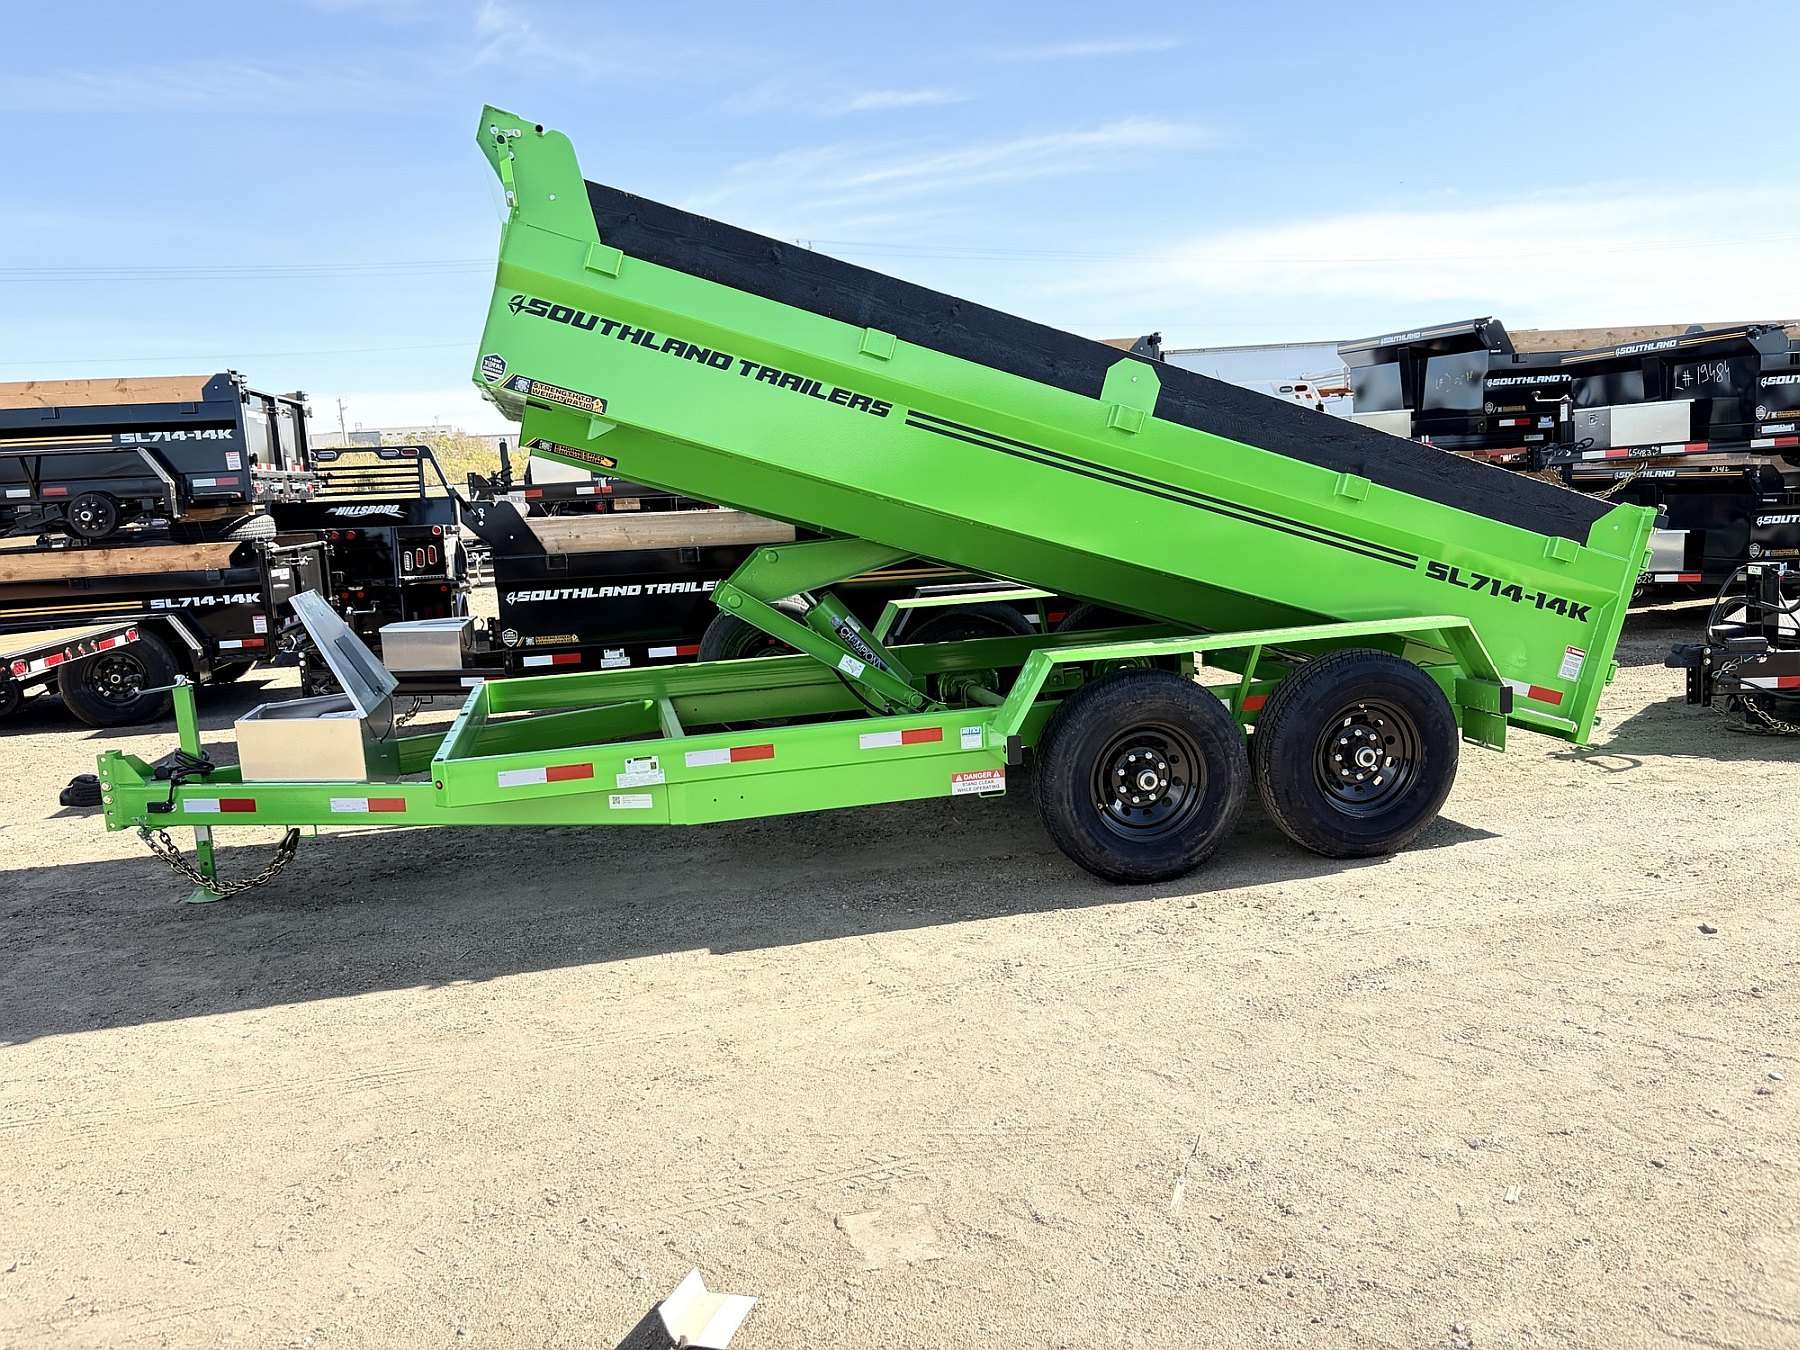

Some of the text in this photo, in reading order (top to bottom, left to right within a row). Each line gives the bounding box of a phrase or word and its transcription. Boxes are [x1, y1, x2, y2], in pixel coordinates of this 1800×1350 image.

[1619, 340, 1677, 355] SOUTHLAND
[524, 298, 893, 418] SOUTHLAND TRAILERS
[1697, 360, 1731, 385] 19484
[1493, 375, 1560, 386] SOUTHLAND
[120, 429, 233, 443] SL714-14K
[1619, 470, 1675, 479] SOTHLAND
[335, 505, 400, 516] HILLSBORO
[1763, 515, 1800, 524] SOUT
[516, 584, 642, 601] SOUTHLAND
[1425, 560, 1592, 623] SL714-14K
[150, 593, 261, 609] SL714-14K
[841, 626, 881, 670] CHAMPION
[964, 771, 992, 781] DANGER
